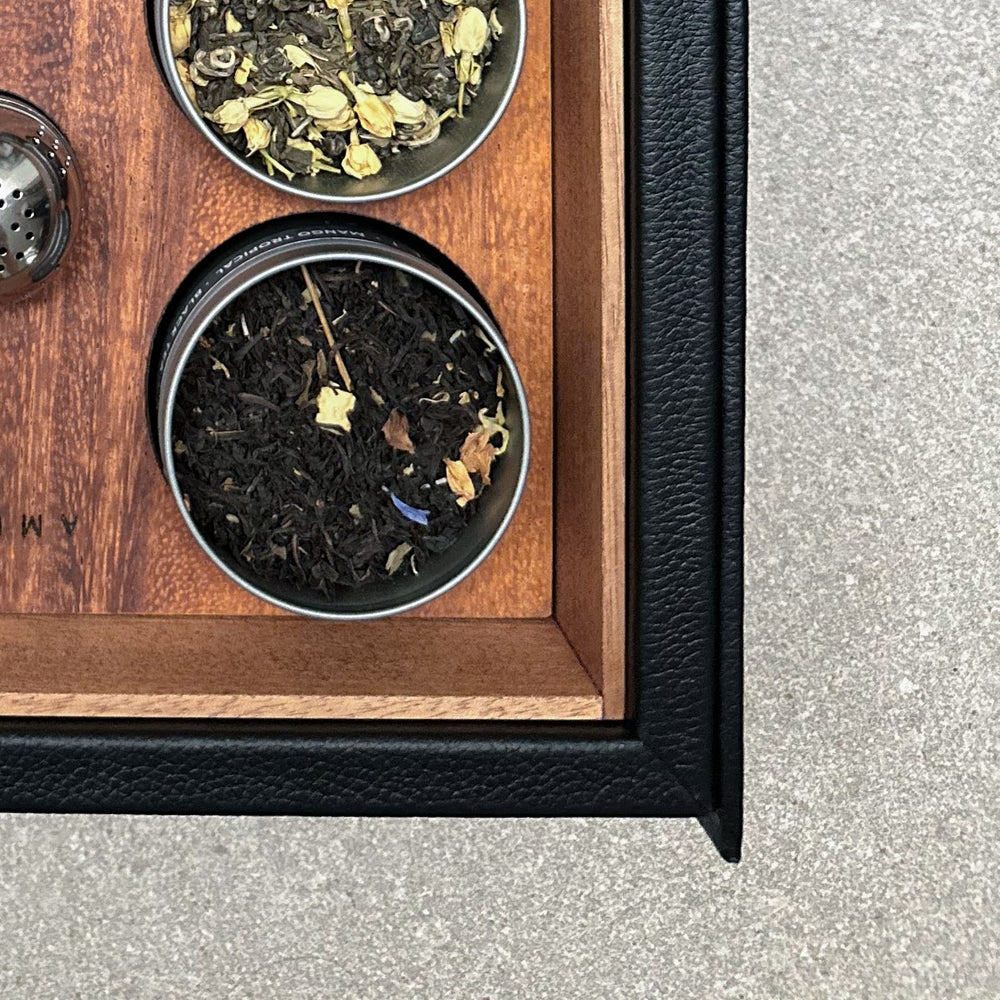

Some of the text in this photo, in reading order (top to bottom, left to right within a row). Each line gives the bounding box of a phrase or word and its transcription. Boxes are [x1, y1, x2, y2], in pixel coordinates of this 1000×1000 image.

[297, 229, 366, 237] MANGO
[215, 234, 294, 274] TROPICAL
[171, 288, 203, 337] BLACK
